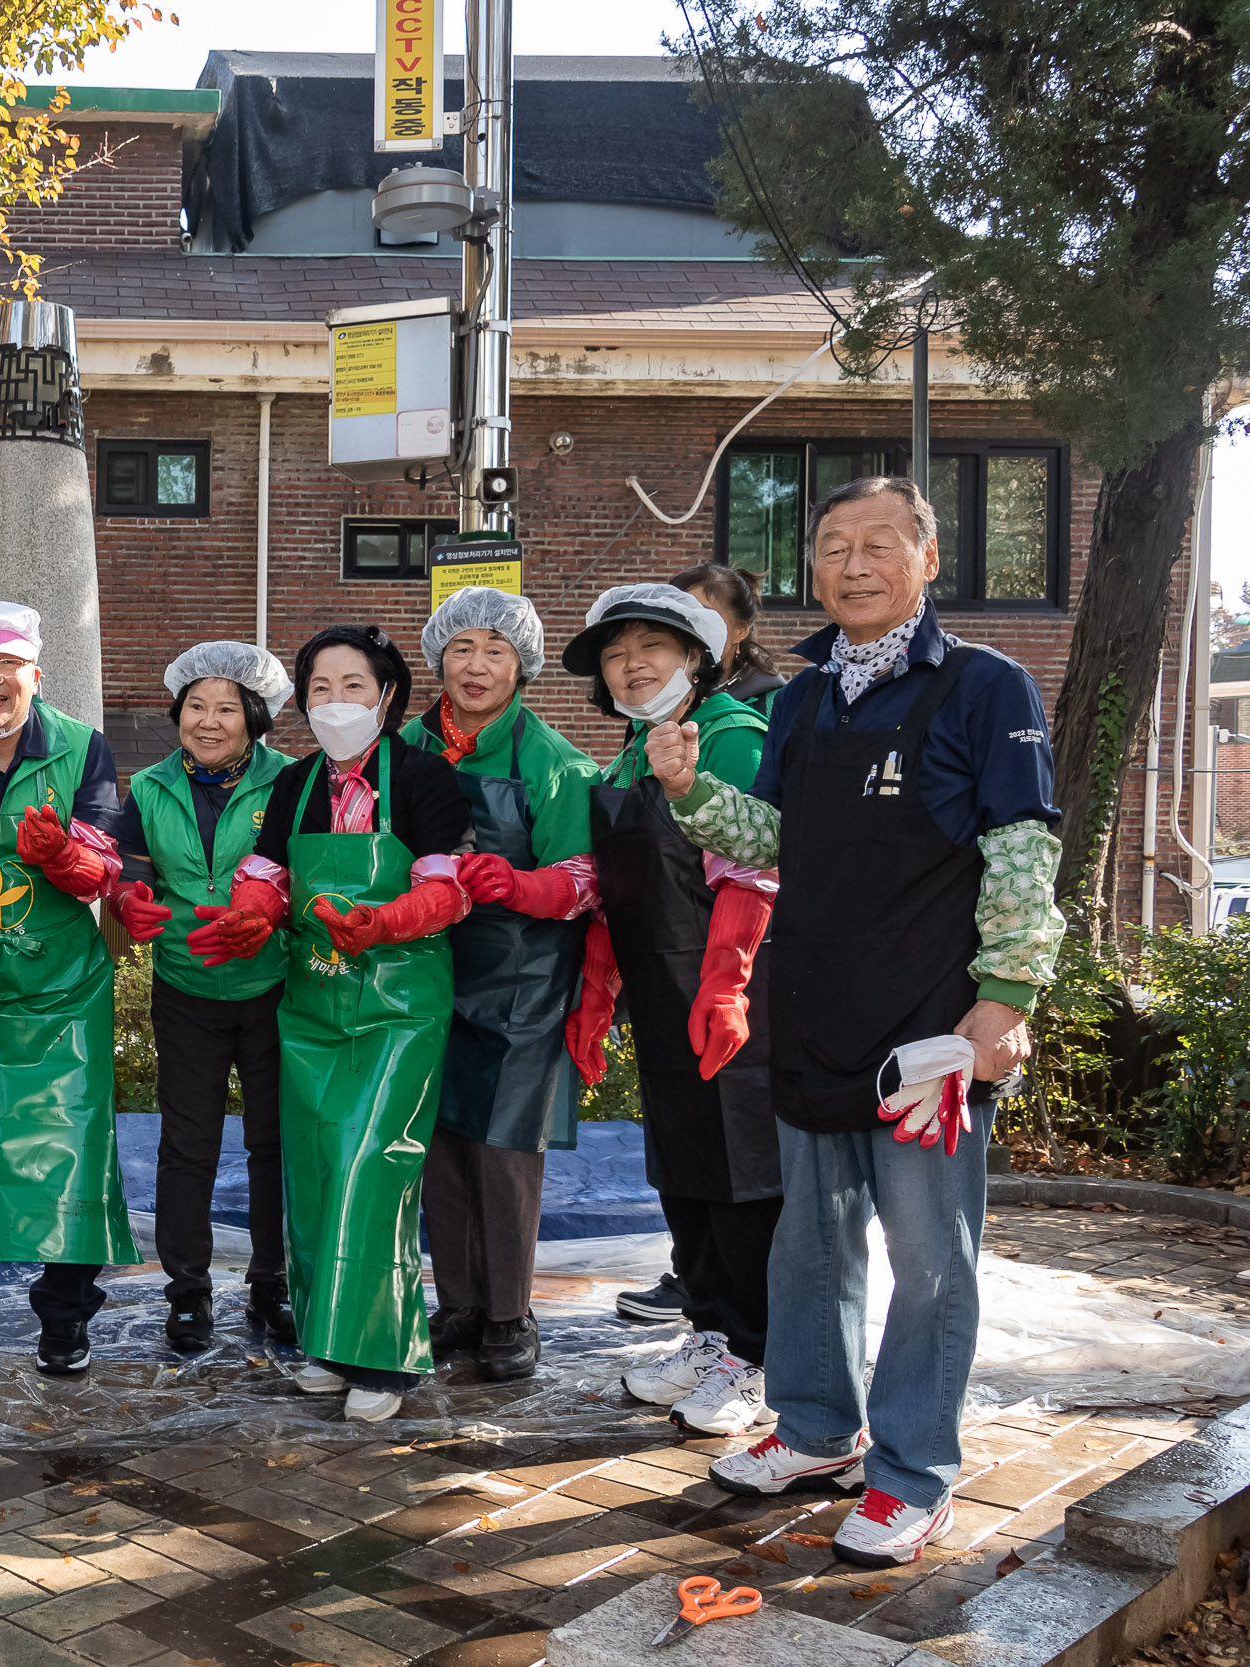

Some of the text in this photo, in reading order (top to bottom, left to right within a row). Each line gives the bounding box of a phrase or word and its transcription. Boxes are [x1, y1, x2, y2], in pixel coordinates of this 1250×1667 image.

[391, 0, 427, 137] CCTV 작동중
[446, 548, 517, 559] 영상정보처리기기 설치안내
[1008, 729, 1026, 739] 2022
